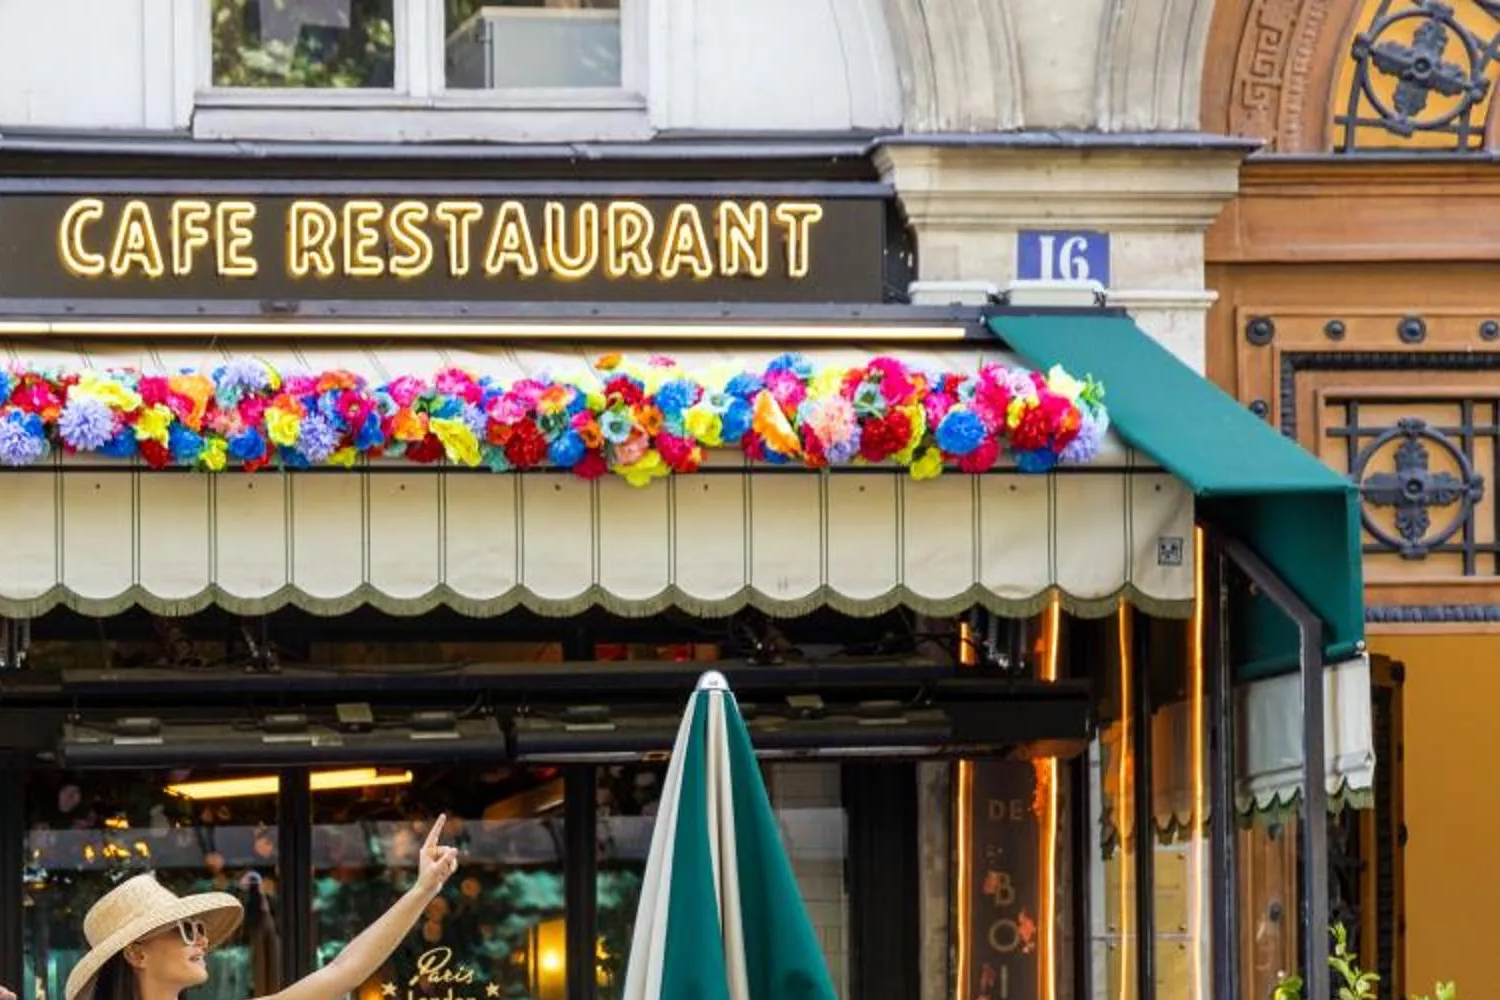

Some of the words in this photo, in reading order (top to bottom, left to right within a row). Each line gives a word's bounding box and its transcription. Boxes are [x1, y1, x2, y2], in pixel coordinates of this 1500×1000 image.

[58, 198, 258, 279] CAFE
[289, 200, 824, 280] RESTAURANT
[1039, 236, 1089, 281] 16
[987, 798, 1023, 821] DE
[408, 946, 475, 987] Paris
